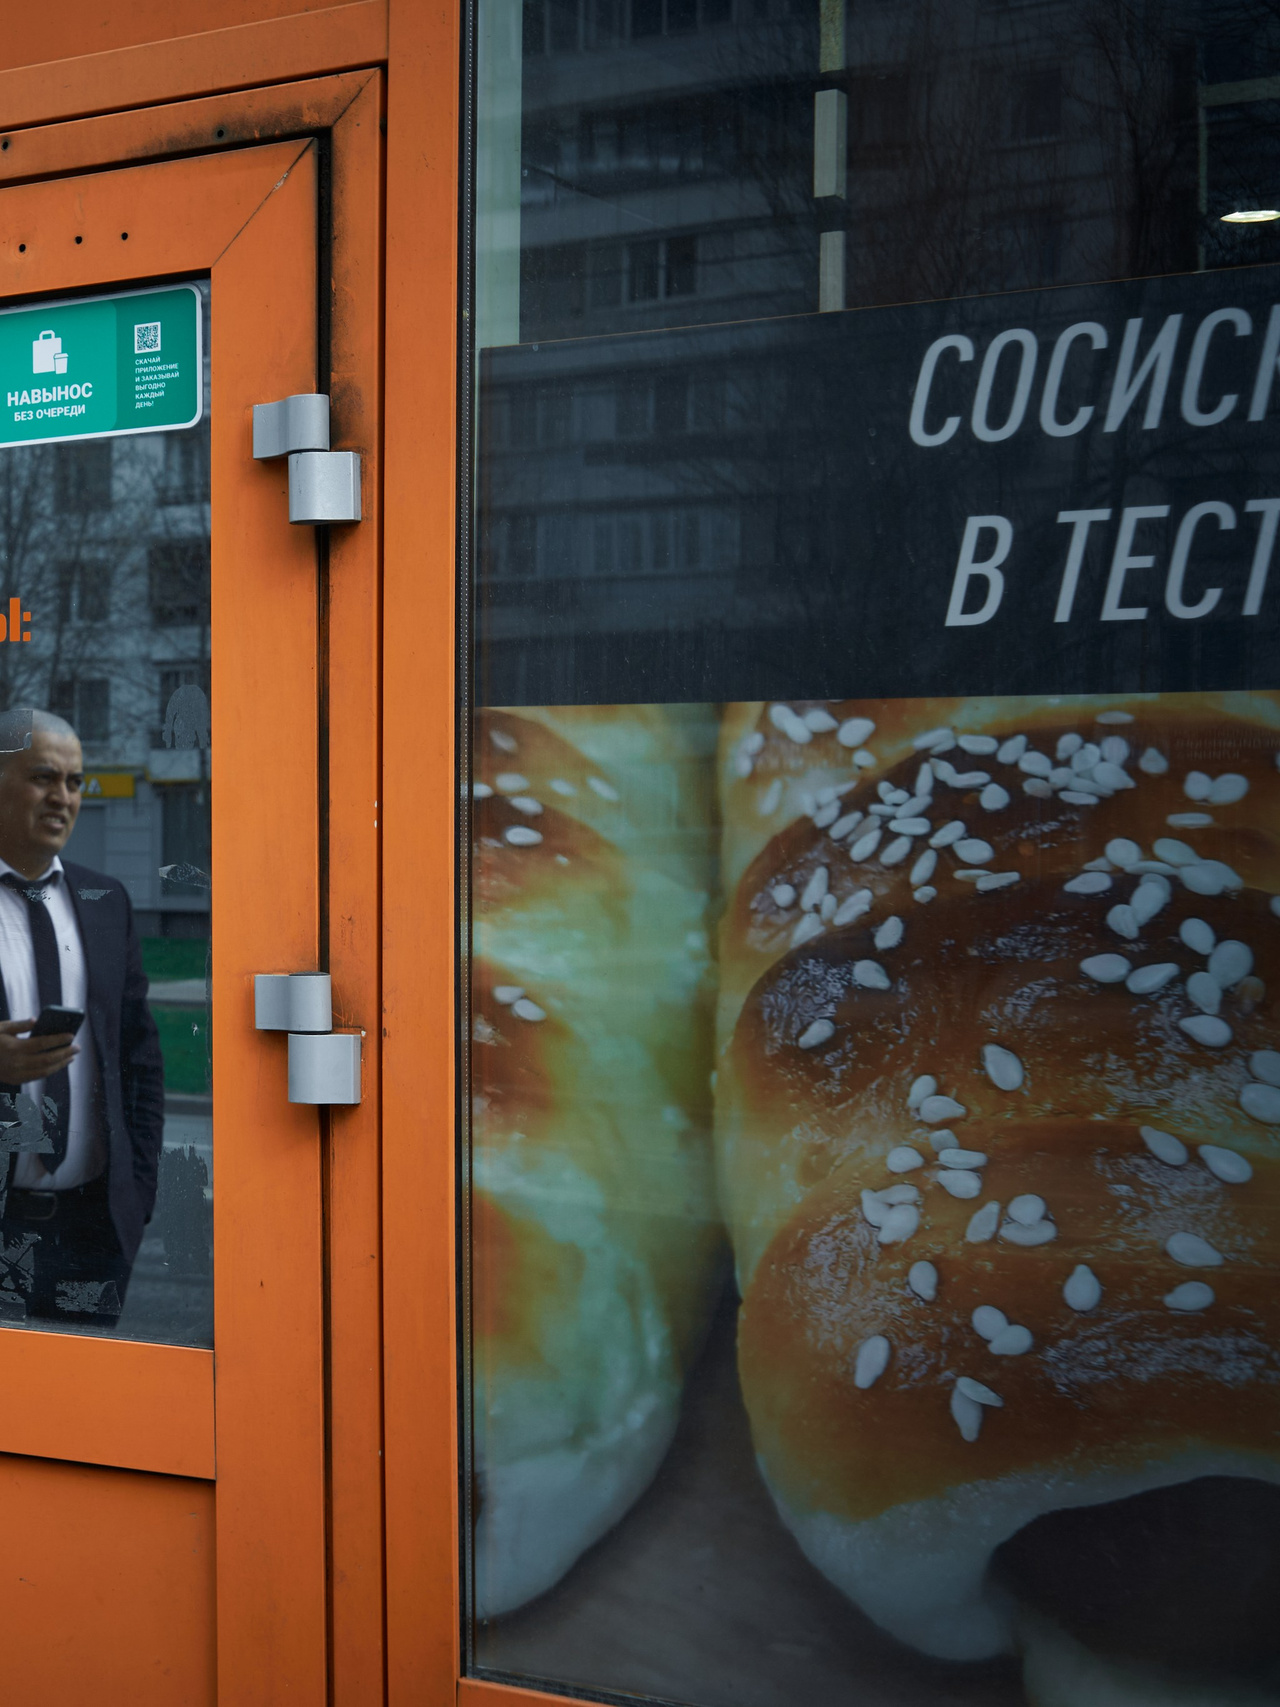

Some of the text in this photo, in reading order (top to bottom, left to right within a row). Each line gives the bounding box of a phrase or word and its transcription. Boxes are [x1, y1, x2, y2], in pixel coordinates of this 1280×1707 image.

[135, 356, 160, 365] СКАЧАЙ
[135, 363, 178, 374] ПРИЛОЖЕНИЕ
[141, 371, 179, 381] ЗАКАЗЫВАЙ
[135, 382, 165, 391] ВЫГОДНО
[7, 382, 93, 407] НАВЫНОС
[135, 390, 164, 399] КАЖДЫЙ
[14, 404, 86, 422] БЕЗ ОЧЕРЕДИ
[944, 497, 1280, 627] В ТЕСТ
